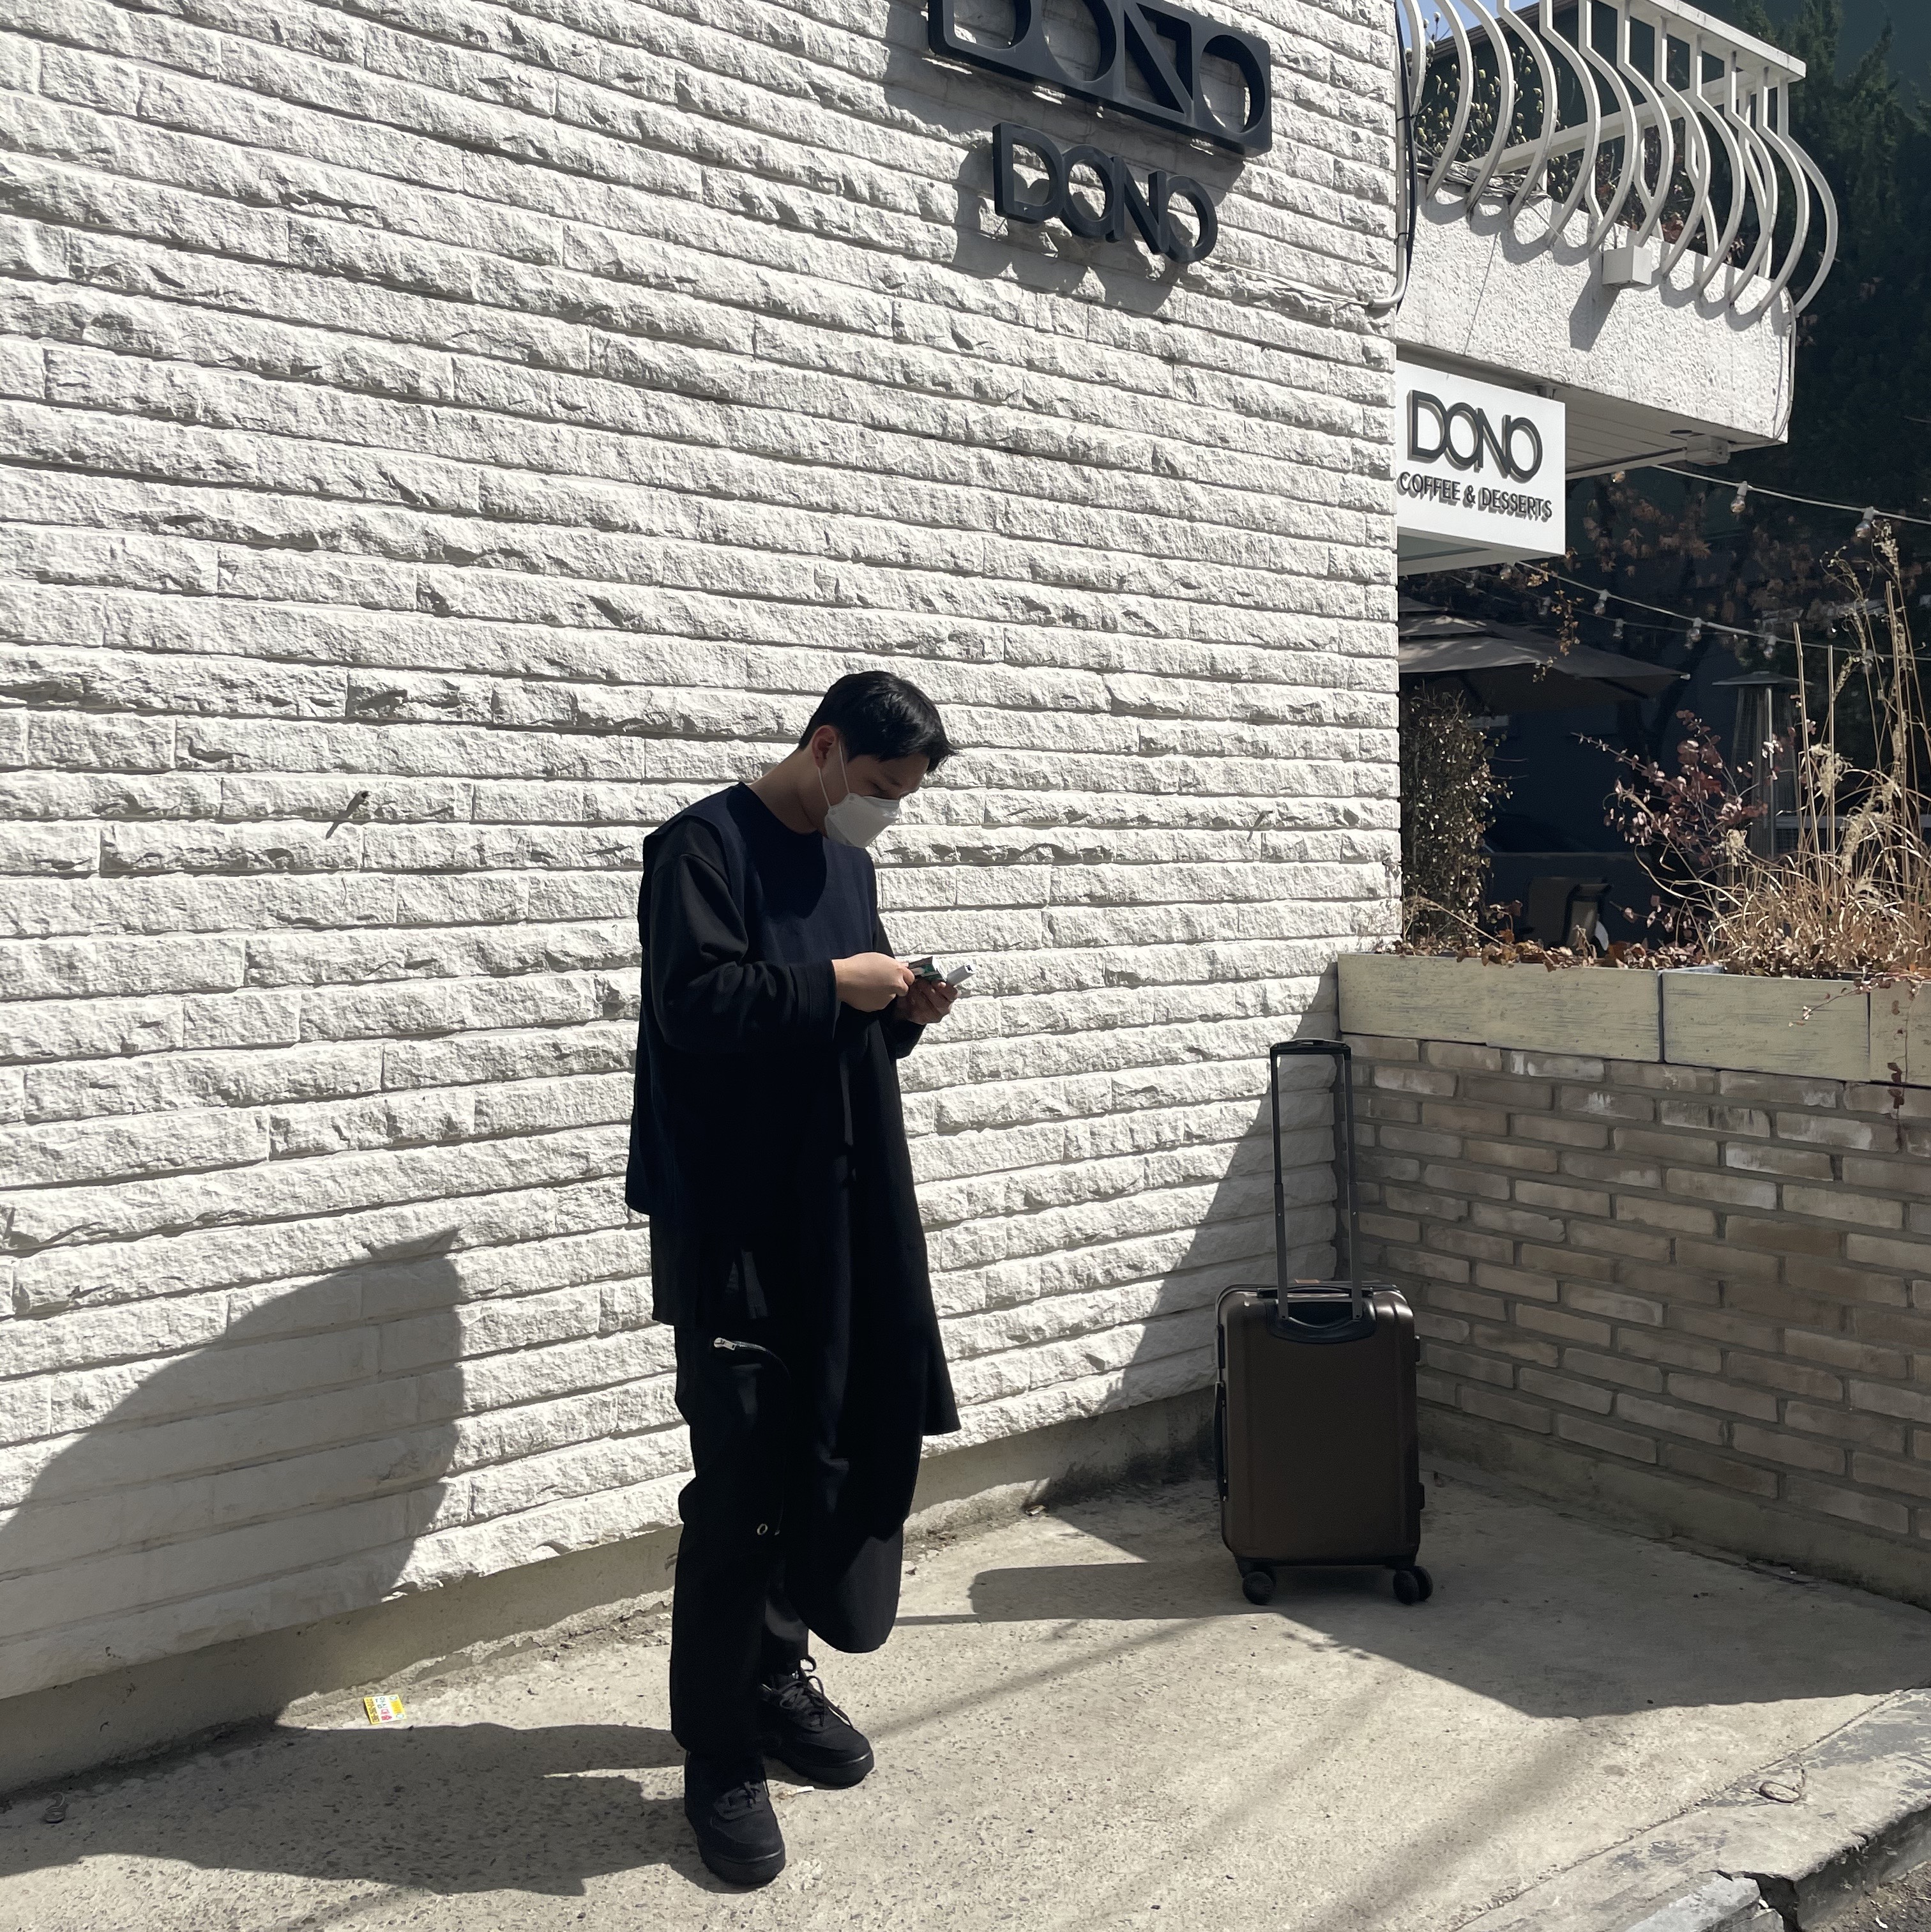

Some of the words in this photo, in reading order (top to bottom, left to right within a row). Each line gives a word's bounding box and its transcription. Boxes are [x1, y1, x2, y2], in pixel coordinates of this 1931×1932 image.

[992, 122, 1218, 264] DONO
[1406, 390, 1543, 483] DONO
[1397, 471, 1460, 506] COFFEE
[1464, 485, 1476, 508] &
[1478, 487, 1552, 522] DESSERTS
